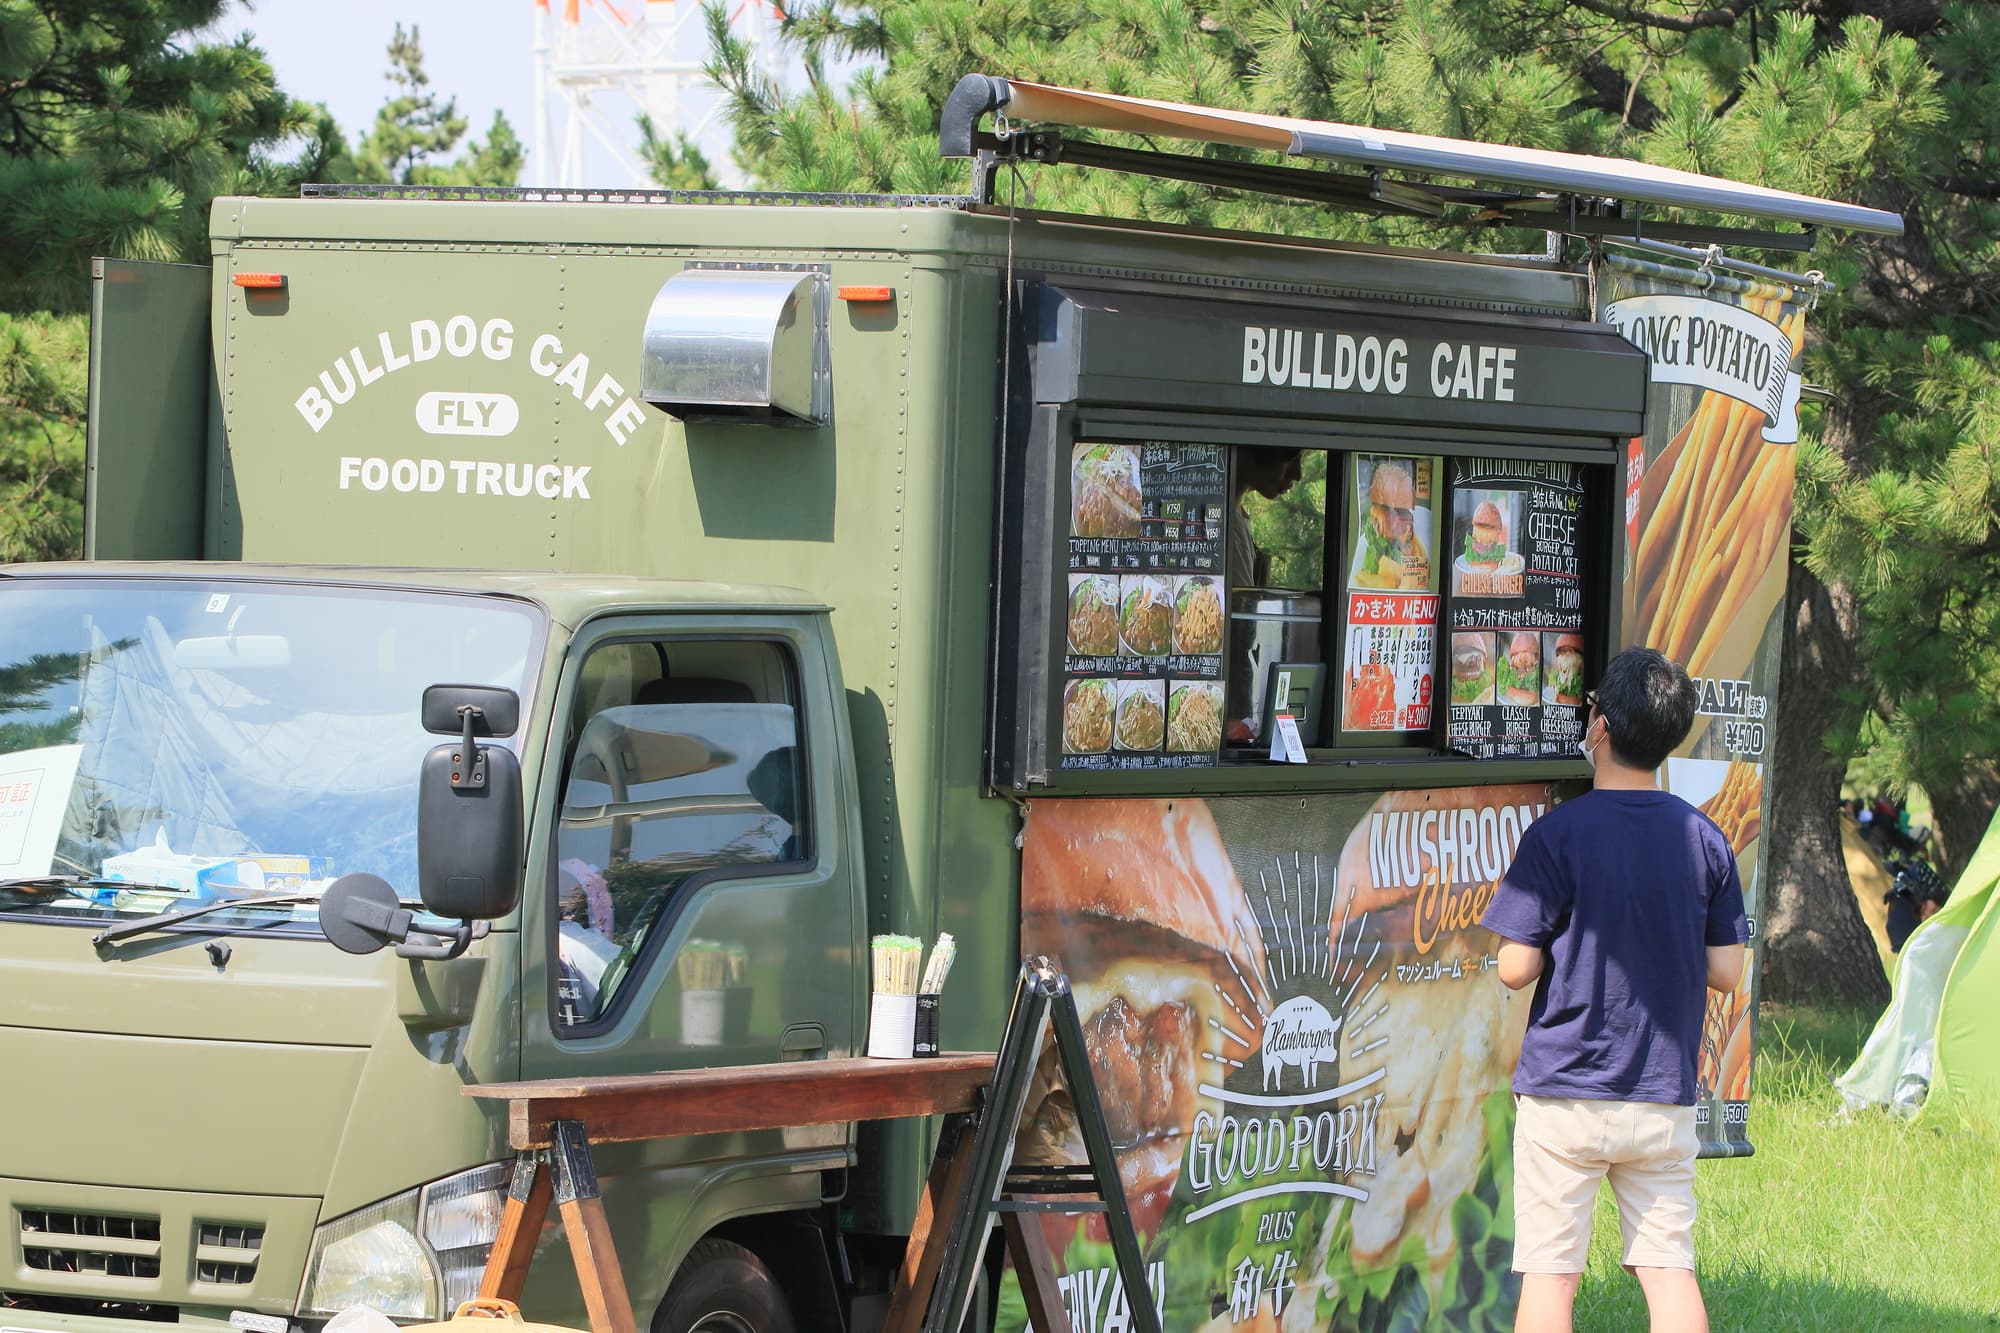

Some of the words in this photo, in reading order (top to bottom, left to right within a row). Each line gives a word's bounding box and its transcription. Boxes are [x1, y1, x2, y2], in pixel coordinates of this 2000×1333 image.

[1242, 326, 1408, 395] BULLDOG
[1430, 342, 1516, 401] CAFE
[1686, 316, 1771, 391] POTATO
[294, 315, 514, 433] BULLDOG
[529, 333, 647, 447] CAFE
[436, 400, 498, 428] FLY
[339, 457, 444, 490] FOOD
[449, 459, 592, 499] TRUCK
[1528, 512, 1577, 545] CHEESE
[1069, 540, 1100, 553] TOPPING
[1101, 540, 1119, 553] MENU
[1536, 541, 1560, 555] BURGER
[1561, 545, 1573, 556] AND
[1565, 557, 1579, 576] SET
[1461, 573, 1492, 594] CHEESE
[1492, 575, 1524, 594] BURGER
[1354, 599, 1396, 619] かき氷
[1402, 600, 1437, 619] MENU
[1407, 706, 1429, 725] ¥300
[1451, 706, 1484, 720] TERIYAKI
[1501, 706, 1531, 720] CLASSIC
[1726, 722, 1764, 754] ¥500
[1266, 1018, 1335, 1053] Hamburger
[1188, 1110, 1288, 1194] GOOD
[1288, 1093, 1385, 1177] PORK
[1256, 1211, 1296, 1244] PLUS
[1229, 1250, 1298, 1324] 和牛
